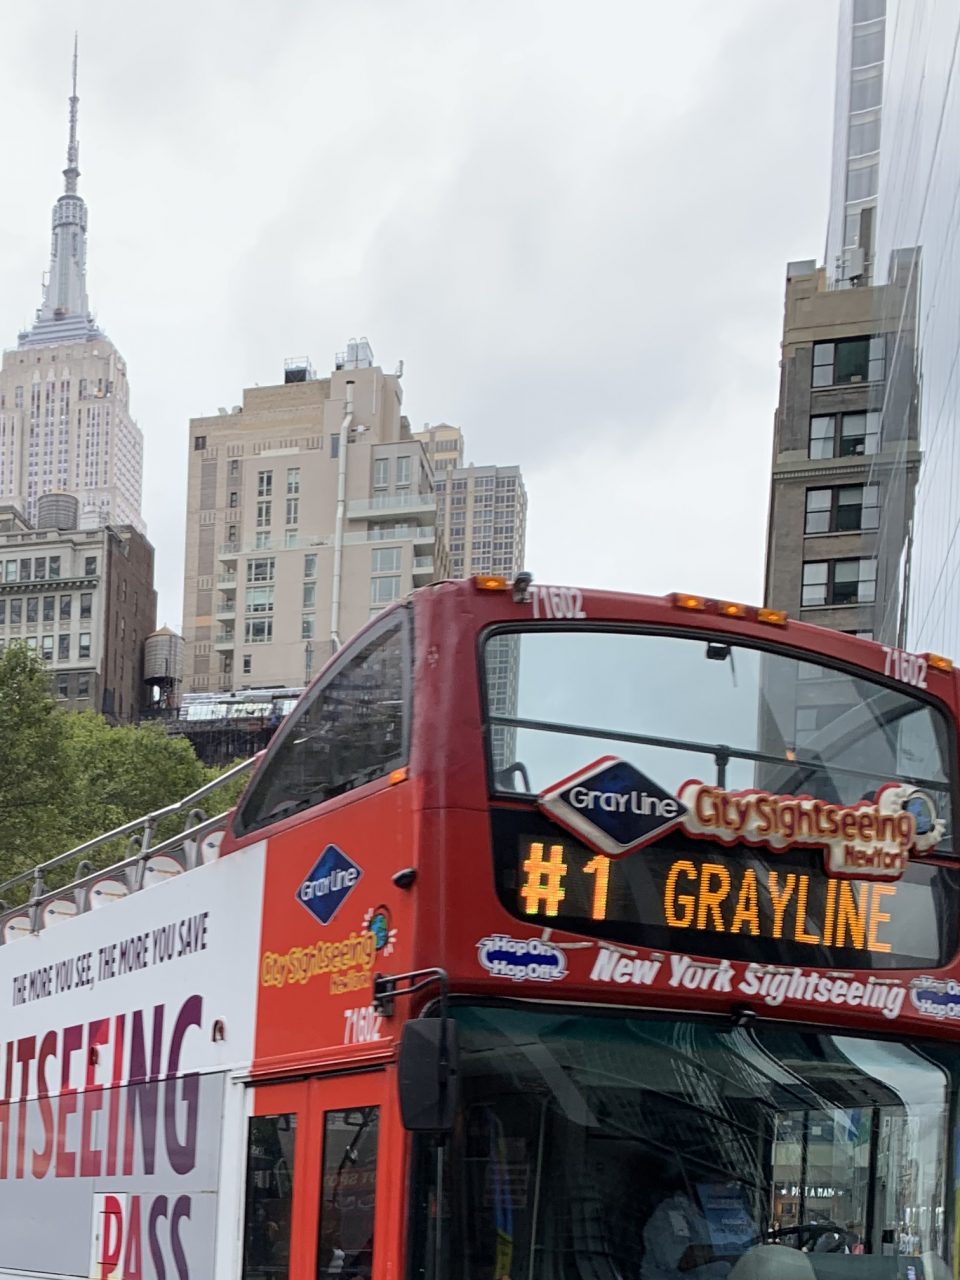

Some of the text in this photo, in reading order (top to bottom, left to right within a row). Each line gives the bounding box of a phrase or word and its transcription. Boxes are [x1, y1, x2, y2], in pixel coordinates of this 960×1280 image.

[528, 586, 586, 618] 71602
[882, 647, 928, 689] 71602
[664, 860, 897, 953] GRAYLINE
[12, 974, 27, 1006] THE
[28, 965, 53, 1002] MORE
[55, 958, 74, 994] YOU
[98, 943, 117, 982] THE
[118, 932, 149, 975] MORE
[152, 923, 176, 965] YOU
[177, 911, 209, 957] SAVE
[590, 949, 906, 1020] New York Sightseeing
[343, 1005, 383, 1045] 71602
